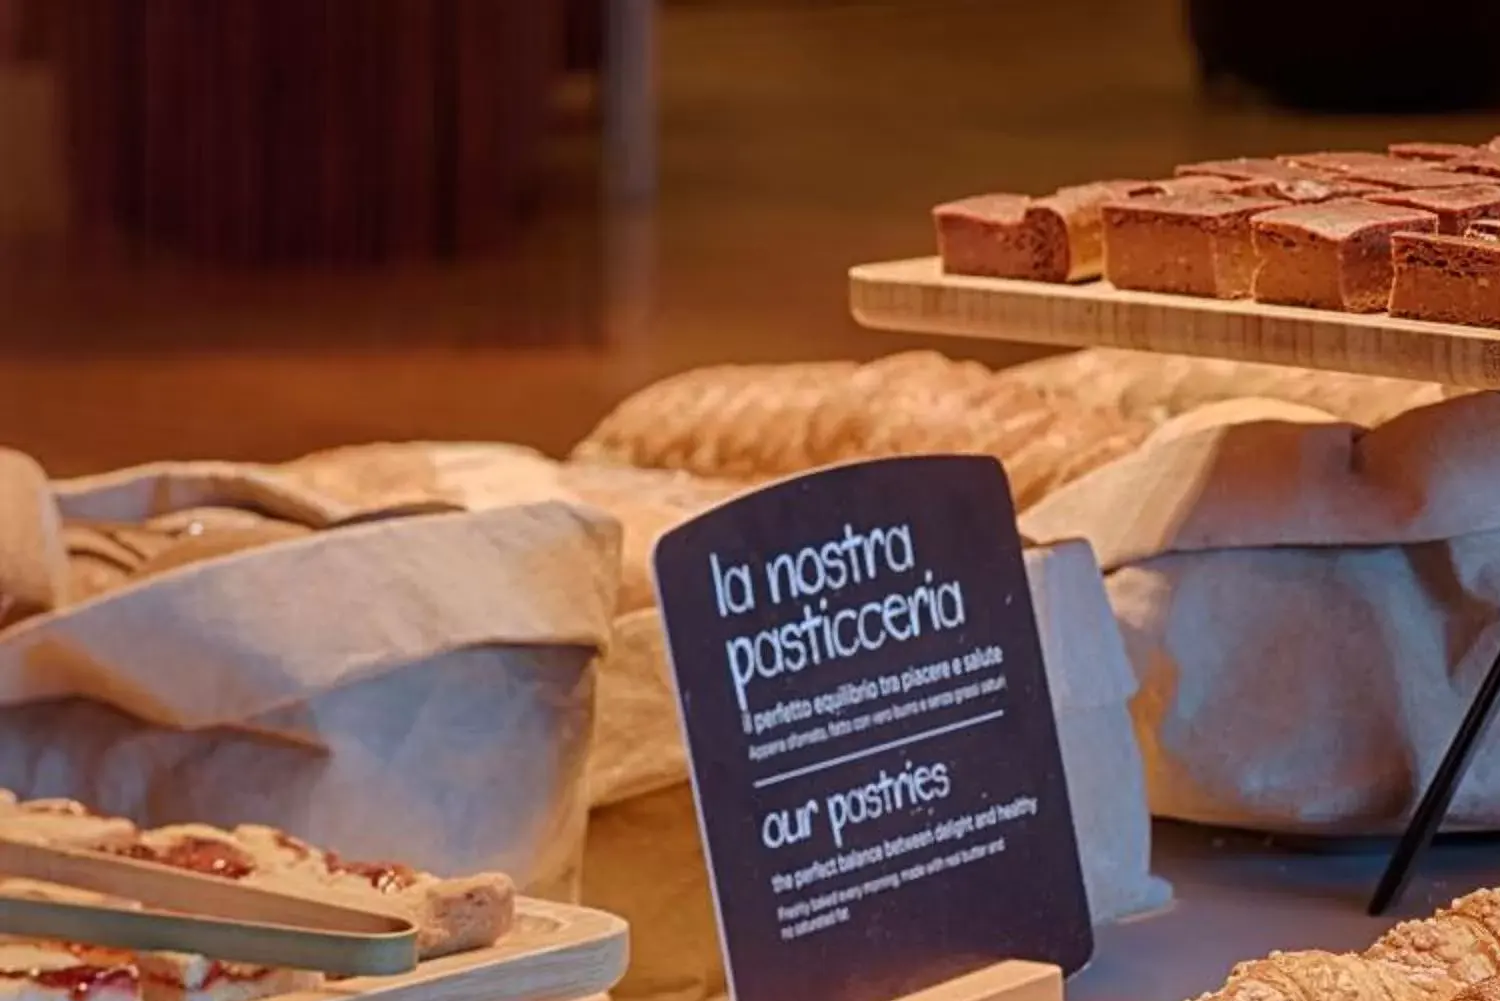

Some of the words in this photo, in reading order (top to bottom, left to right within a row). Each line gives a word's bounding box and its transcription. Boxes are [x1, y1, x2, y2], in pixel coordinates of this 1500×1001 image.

[710, 552, 754, 618] la
[768, 523, 916, 604] nostra
[725, 569, 965, 711] pasticceria
[753, 700, 812, 735] perfetto
[813, 679, 879, 715] equilibrio
[878, 675, 901, 697] tra
[900, 660, 951, 693] piacere
[952, 657, 962, 675] e
[963, 645, 1003, 673] salute
[761, 796, 820, 849] our
[827, 758, 951, 848] pastries
[771, 873, 793, 894] the
[794, 859, 838, 890] perfect
[838, 844, 884, 873] balance
[884, 828, 934, 857] between
[935, 816, 974, 842] delight
[975, 805, 997, 829] and
[997, 796, 1038, 821] healthy
